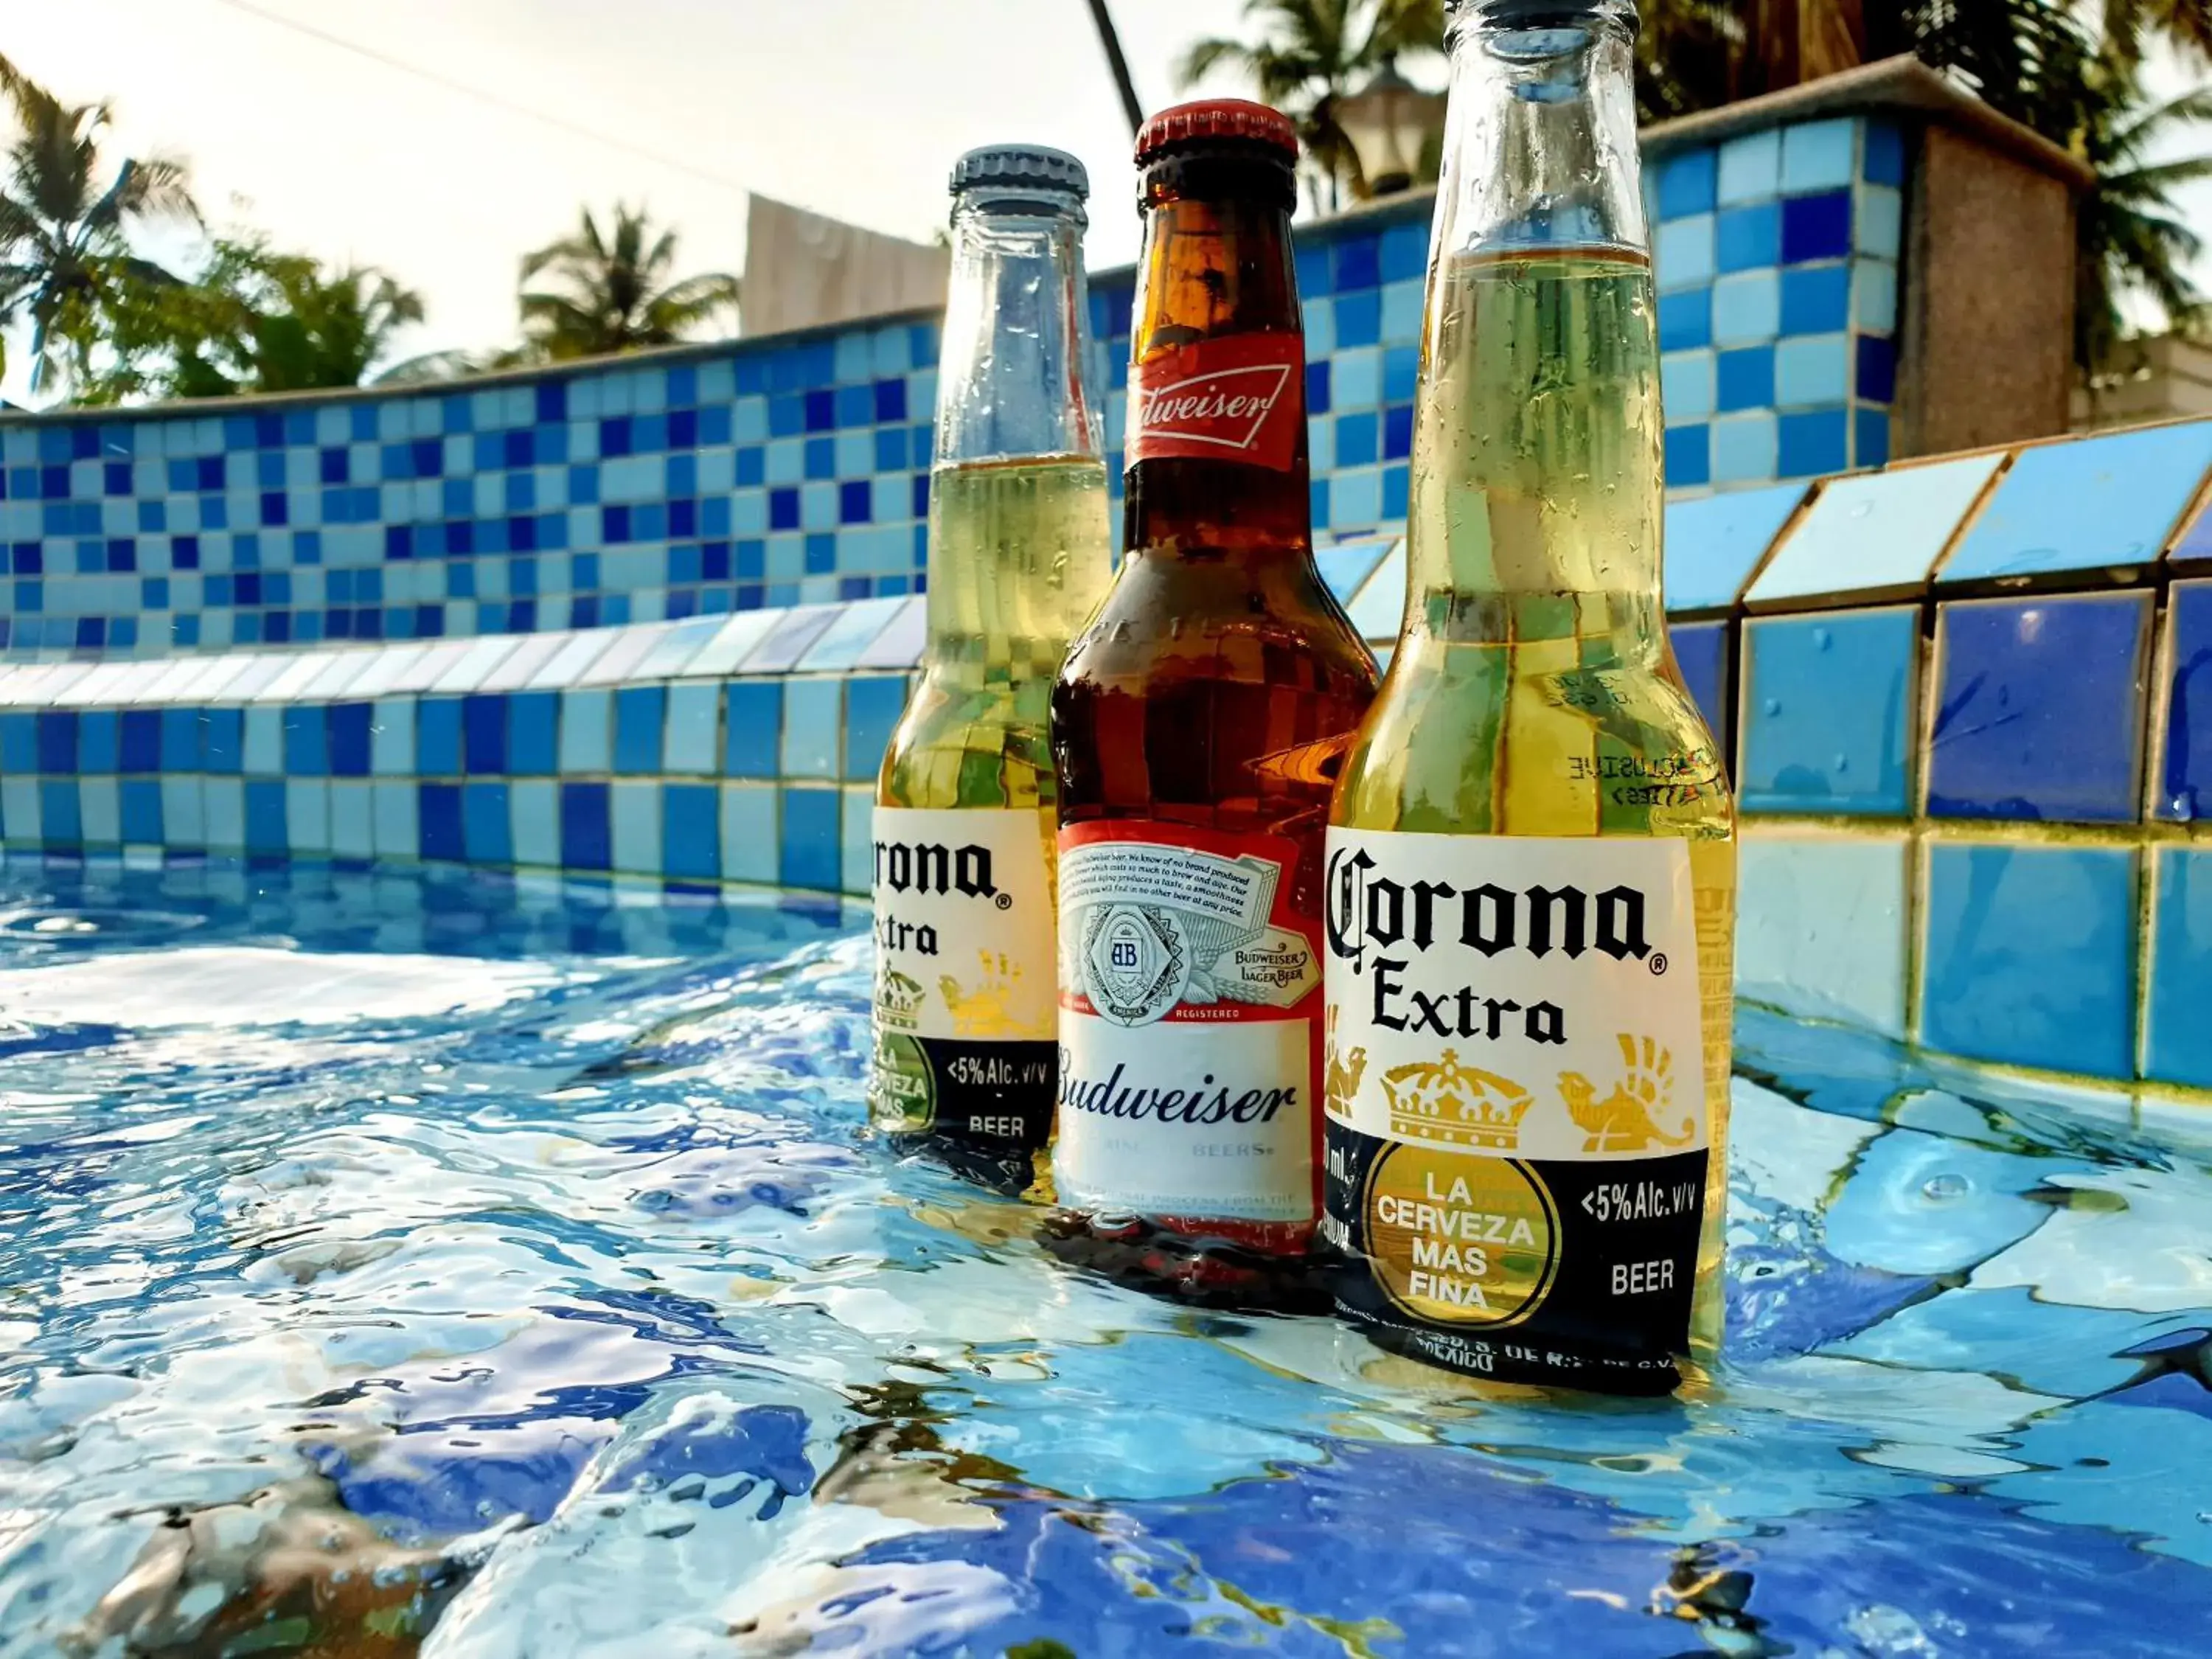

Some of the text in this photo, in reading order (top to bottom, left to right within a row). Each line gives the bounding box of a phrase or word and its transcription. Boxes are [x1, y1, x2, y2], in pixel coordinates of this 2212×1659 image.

[1141, 387, 1271, 427] dweiser
[876, 841, 998, 898] rona
[1138, 866, 1160, 874] much
[1172, 870, 1194, 880] brew
[1194, 874, 1211, 885] and
[1231, 885, 1248, 896] Our
[1141, 853, 1163, 863] know
[1163, 857, 1173, 865] of
[1185, 860, 1211, 874] brand
[1210, 869, 1251, 886] produced
[1150, 887, 1172, 898] other
[1173, 891, 1192, 902] beer
[1192, 897, 1203, 905] at
[1202, 900, 1219, 911] any
[1193, 885, 1245, 906] smoothness
[1326, 846, 1652, 975] Corona
[876, 914, 939, 956] tra
[1175, 1009, 1240, 1019] REGISTERED
[1370, 956, 1568, 1046] Extra
[968, 1115, 1026, 1138] BEER
[1427, 1172, 1472, 1206] LA
[1377, 1194, 1535, 1246] CERVEZA
[1412, 1236, 1488, 1276] MAS
[1409, 1270, 1489, 1310] FINA
[1611, 1259, 1674, 1295] BEER
